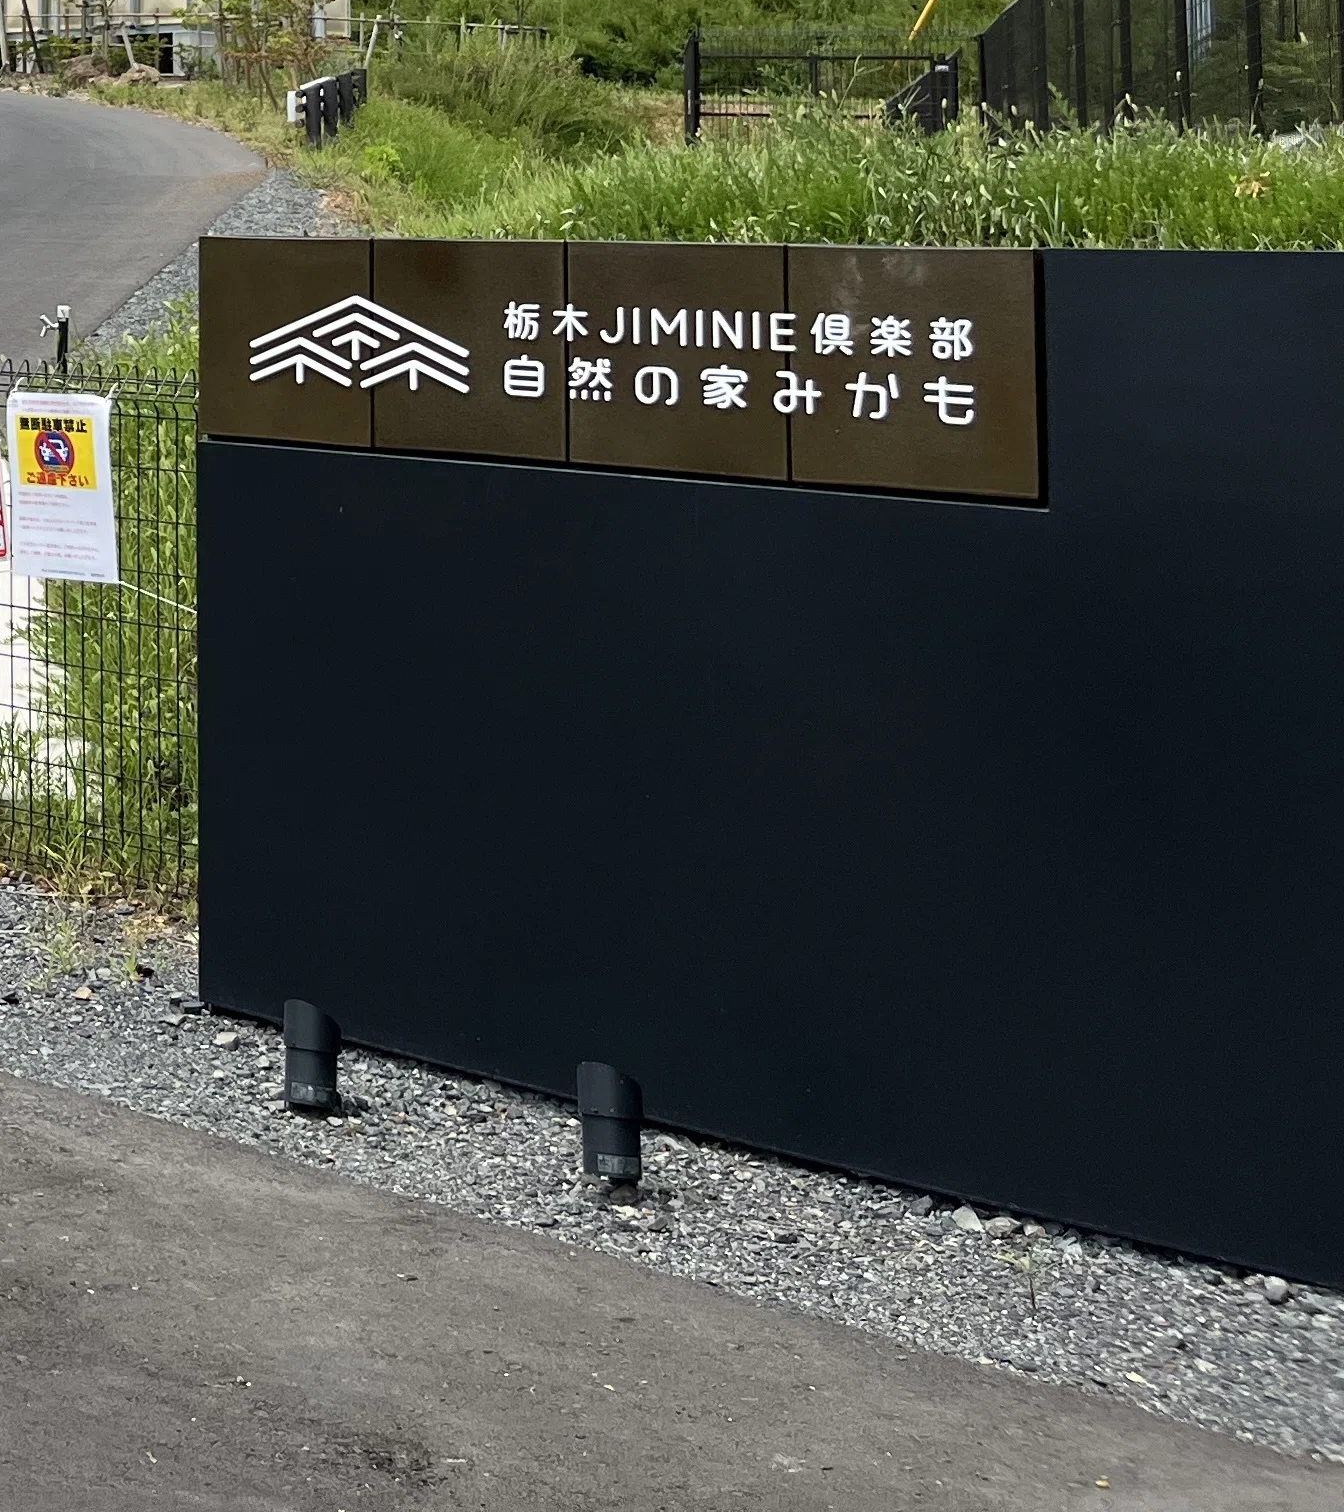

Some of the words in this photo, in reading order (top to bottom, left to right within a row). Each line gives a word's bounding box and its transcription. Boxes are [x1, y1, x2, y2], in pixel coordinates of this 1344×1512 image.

[503, 301, 974, 361] 栃木JIMINIE倶楽部
[502, 354, 975, 425] 自然の家みかも
